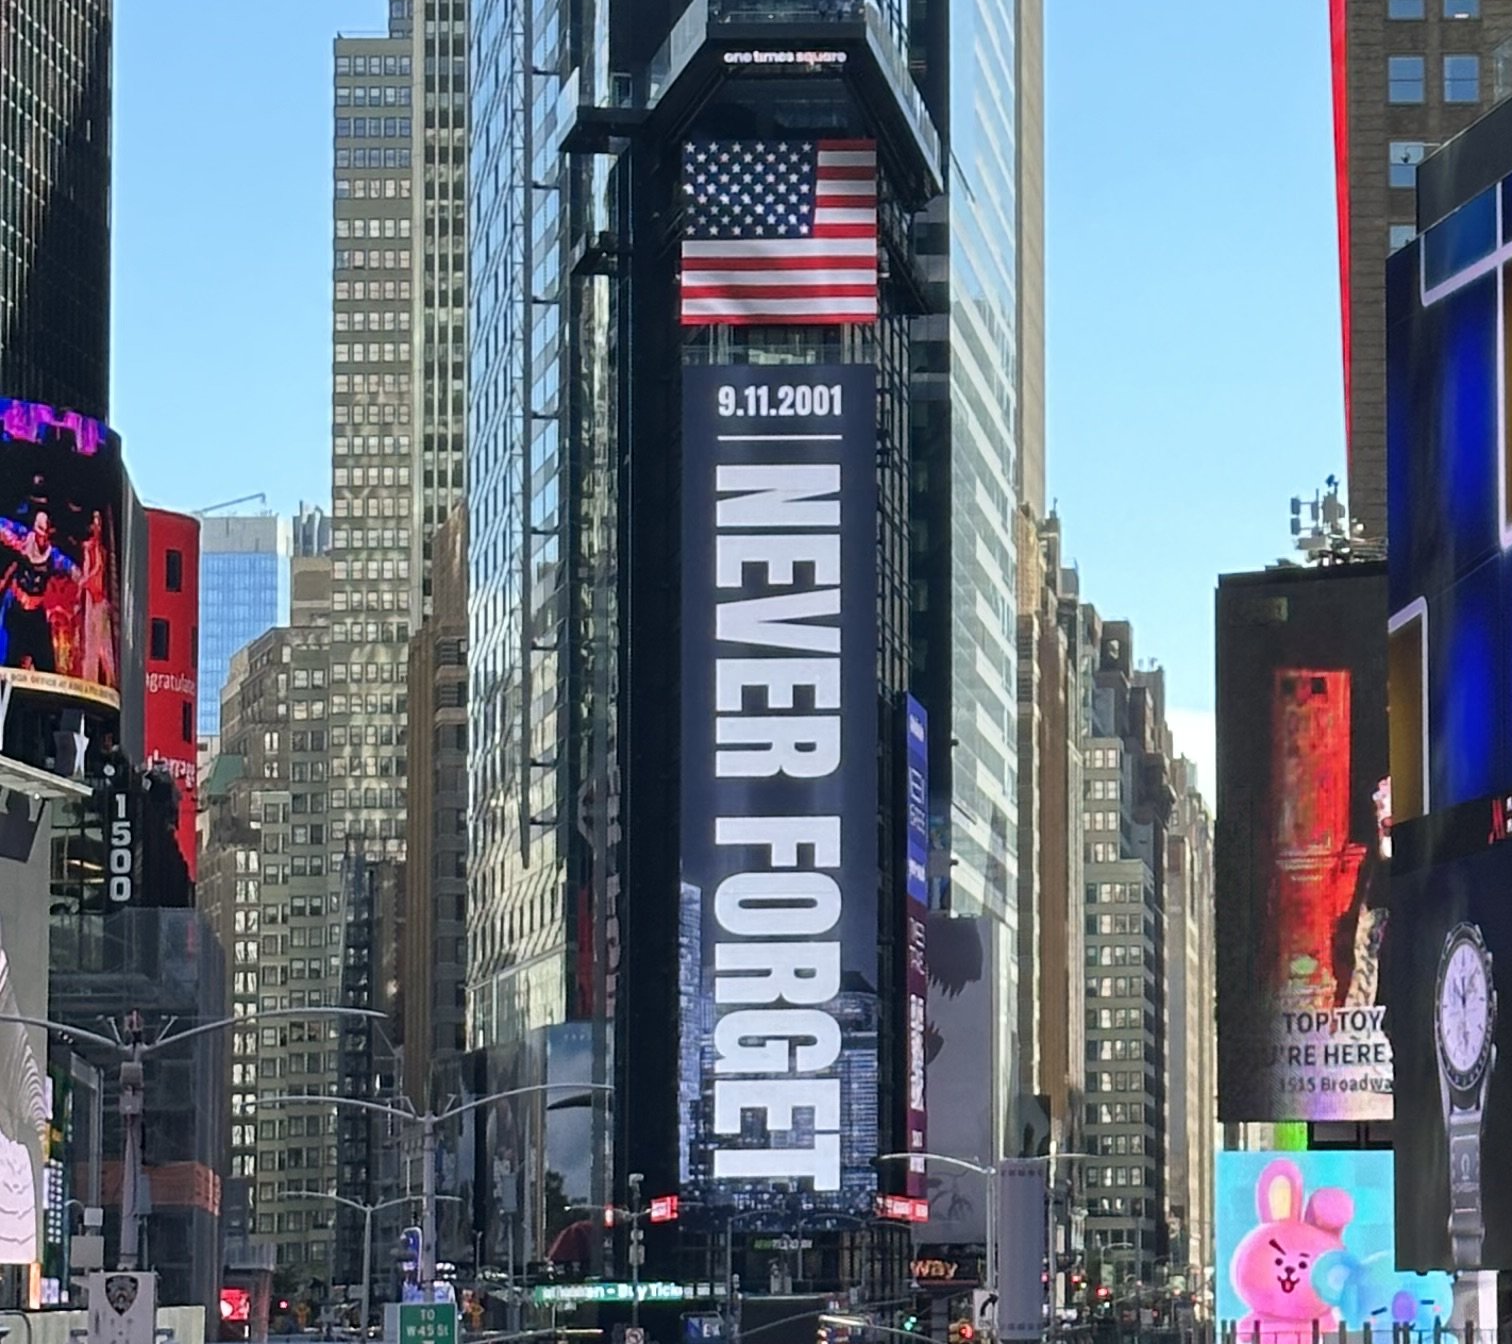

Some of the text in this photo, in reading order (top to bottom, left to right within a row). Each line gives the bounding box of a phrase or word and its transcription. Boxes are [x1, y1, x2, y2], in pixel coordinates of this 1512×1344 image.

[717, 384, 843, 417] 9.11.2001
[715, 464, 842, 777] NEVER
[109, 792, 132, 902] 1500
[714, 816, 842, 1191] FORGET
[1282, 1012, 1329, 1034] TOP
[1321, 1073, 1394, 1094] Broadwa
[419, 1309, 436, 1321] TO
